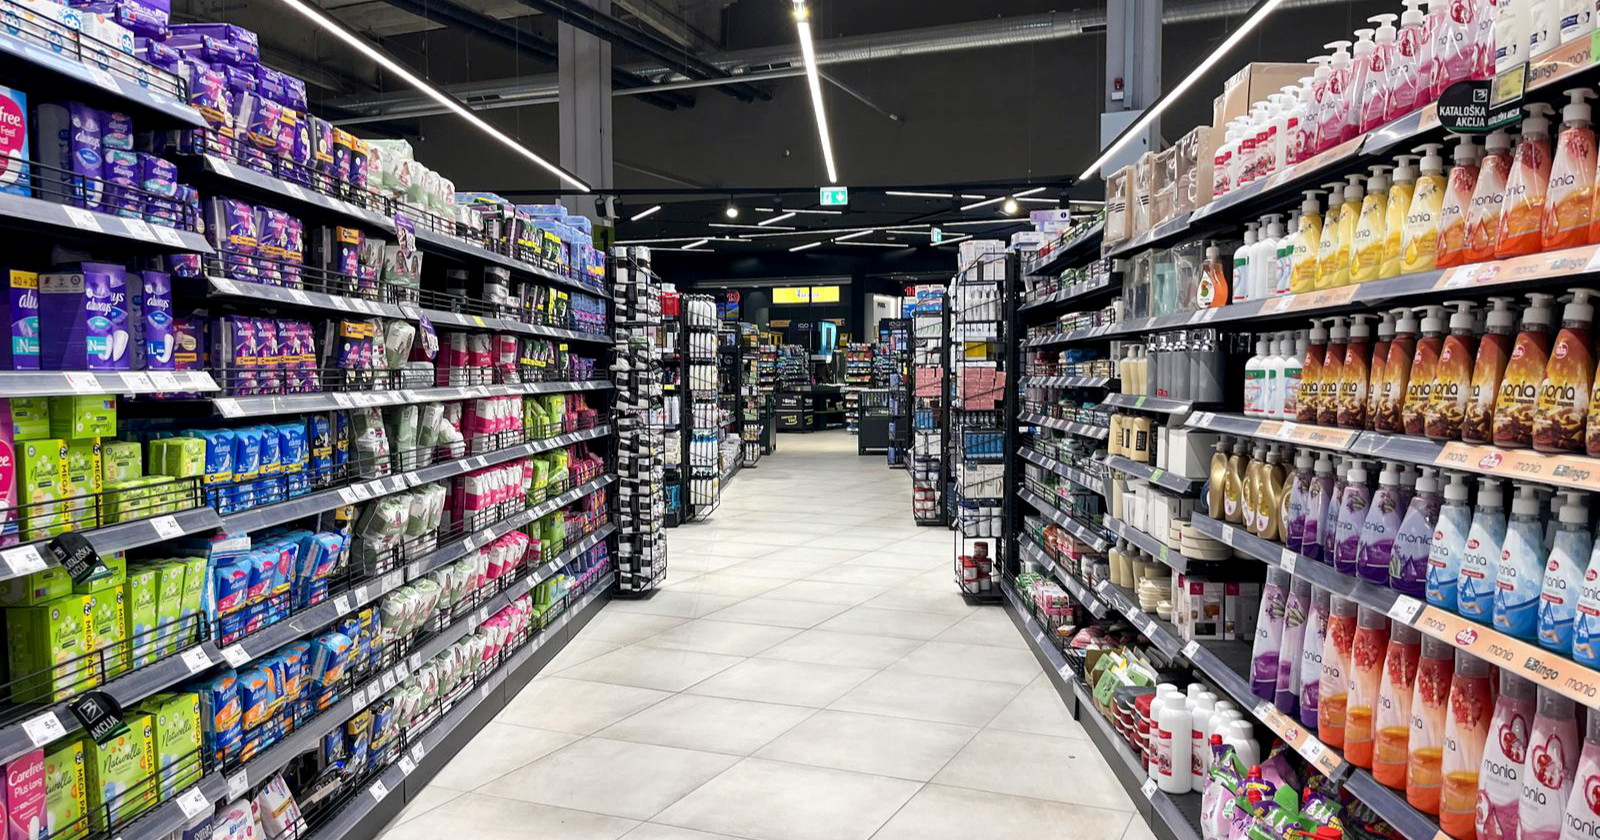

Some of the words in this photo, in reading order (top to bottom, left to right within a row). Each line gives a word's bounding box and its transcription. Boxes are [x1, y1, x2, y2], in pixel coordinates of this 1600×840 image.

[1440, 105, 1486, 116] KATALOŠKA
[1456, 116, 1485, 127] AKCIJA
[1506, 184, 1526, 196] onia
[1442, 204, 1460, 216] onia
[1355, 228, 1371, 239] onia
[86, 300, 112, 316] always
[147, 295, 170, 311] always
[1321, 382, 1336, 392] onia
[1342, 382, 1358, 392] onia
[1513, 461, 1541, 473] monia
[1337, 521, 1352, 530] onia
[1432, 544, 1449, 556] onia
[1464, 553, 1487, 566] onia
[1499, 564, 1516, 577] onia
[1546, 576, 1566, 590] onia
[1582, 586, 1600, 601] onia
[1304, 651, 1322, 664] onia
[1424, 616, 1446, 632] monia
[1488, 643, 1514, 662] monia
[1534, 660, 1559, 681] Bingo
[1565, 676, 1597, 698] monia
[1322, 664, 1340, 678] onia
[90, 715, 119, 740] AKCIJA
[162, 720, 192, 747] Naturella
[104, 743, 141, 773] Naturella
[8, 760, 45, 787] Carefree
[1484, 759, 1517, 780] monia
[46, 770, 73, 794] turella
